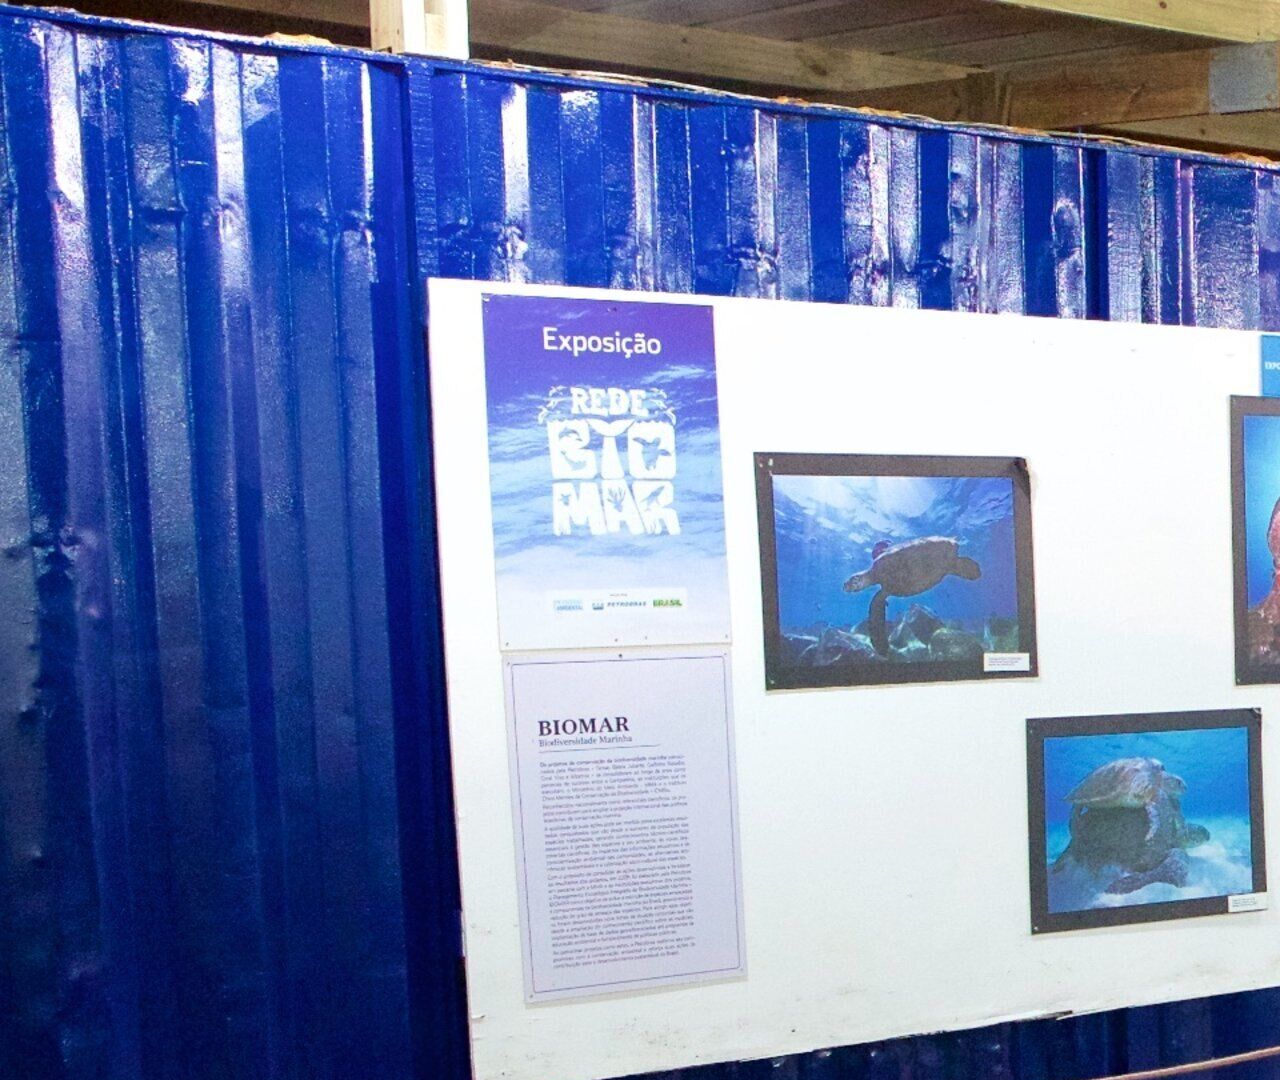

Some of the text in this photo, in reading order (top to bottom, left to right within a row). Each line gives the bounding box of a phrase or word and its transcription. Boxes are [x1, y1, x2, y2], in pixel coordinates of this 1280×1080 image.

[542, 326, 662, 359] Exposição
[569, 386, 649, 416] REDE
[551, 480, 681, 536] MAR
[538, 716, 630, 737] BIOMAR
[538, 735, 634, 748] Biodiversidade Marinha
